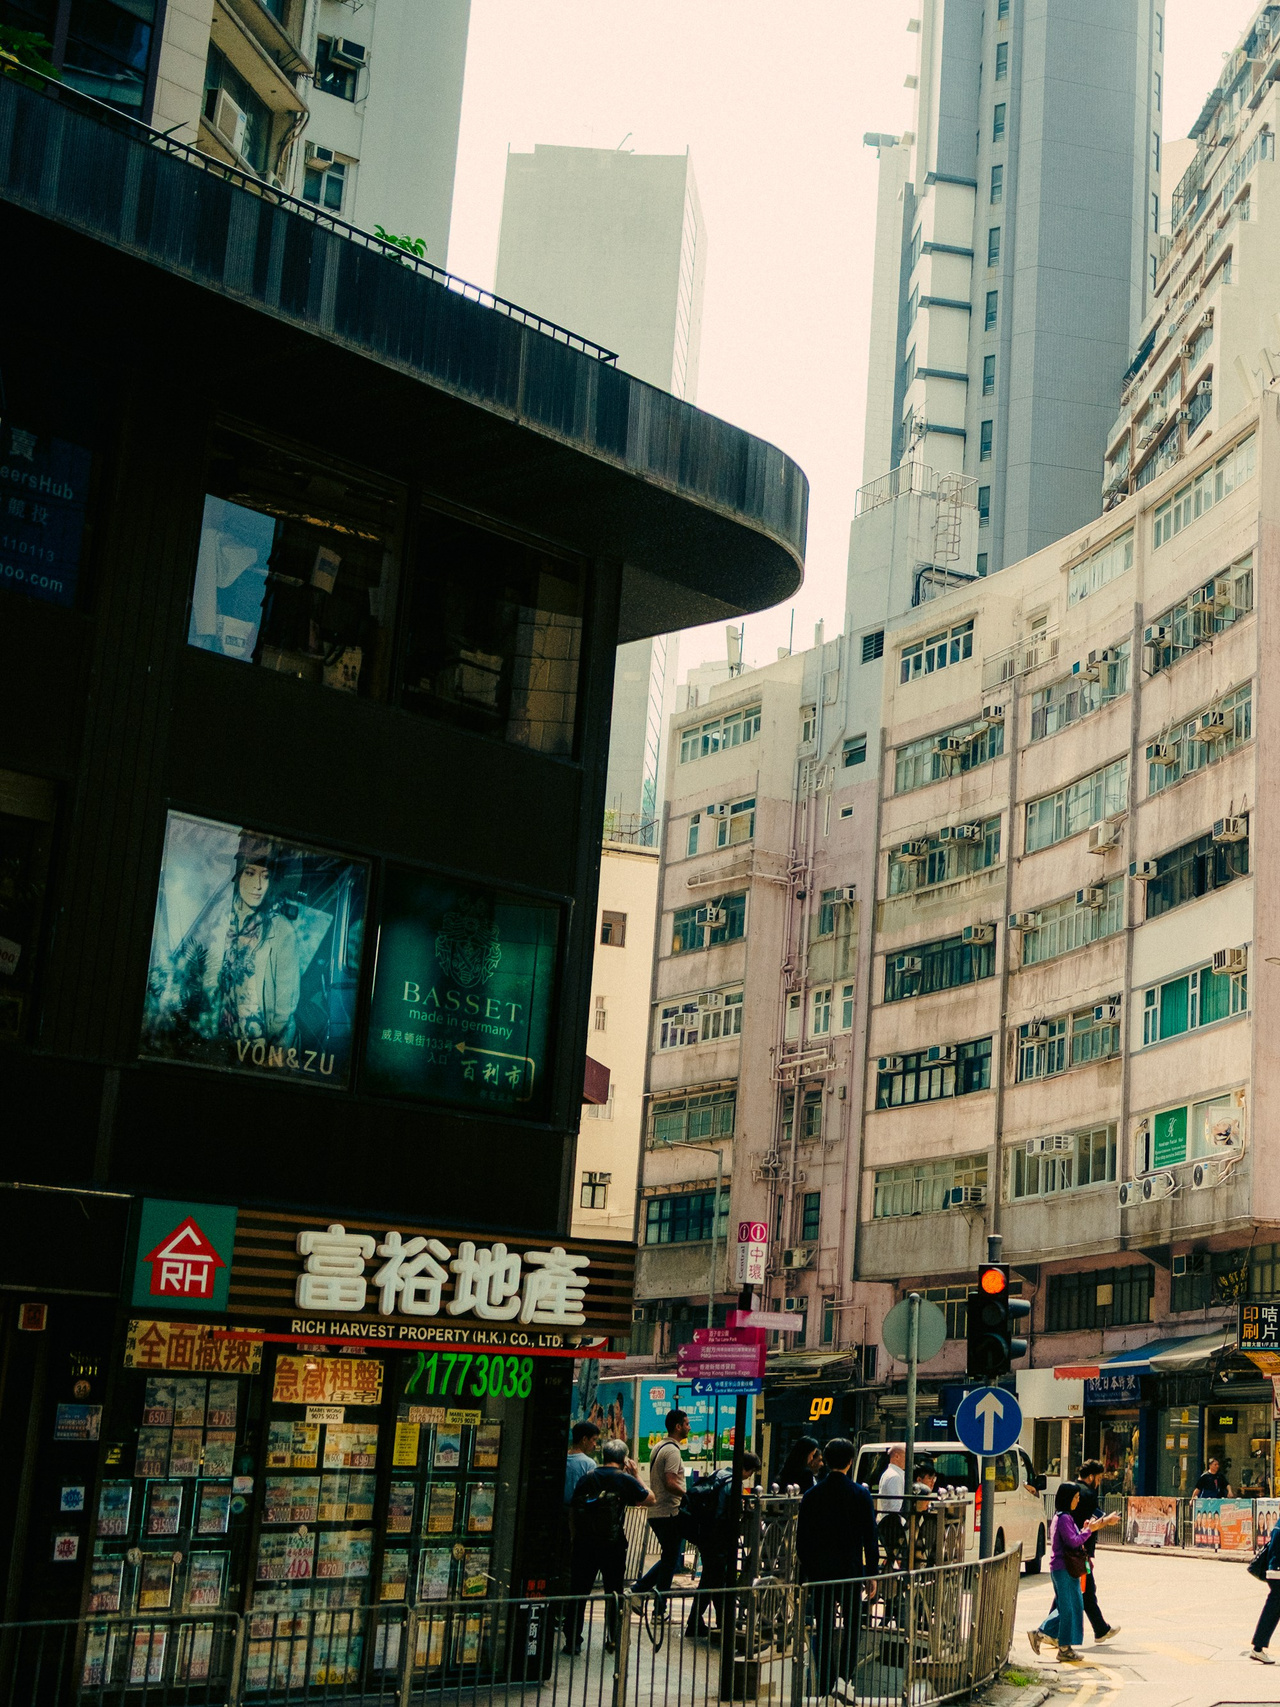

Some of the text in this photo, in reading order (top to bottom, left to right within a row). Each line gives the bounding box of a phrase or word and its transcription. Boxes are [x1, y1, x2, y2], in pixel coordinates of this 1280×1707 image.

[402, 981, 522, 1023] BASSET
[409, 1009, 513, 1041] made in germany
[236, 1040, 335, 1075] VON&ZU
[160, 1261, 209, 1294] RH
[295, 1223, 591, 1326] 富裕地產
[749, 1246, 764, 1280] 中環
[291, 1319, 564, 1349] RICH HARVEST PROPERTY (H.K.) CO., LTD.
[1242, 1306, 1259, 1340] 印刷
[1261, 1306, 1278, 1340] 咭片
[404, 1351, 535, 1399] 21773038
[808, 1397, 834, 1421] go
